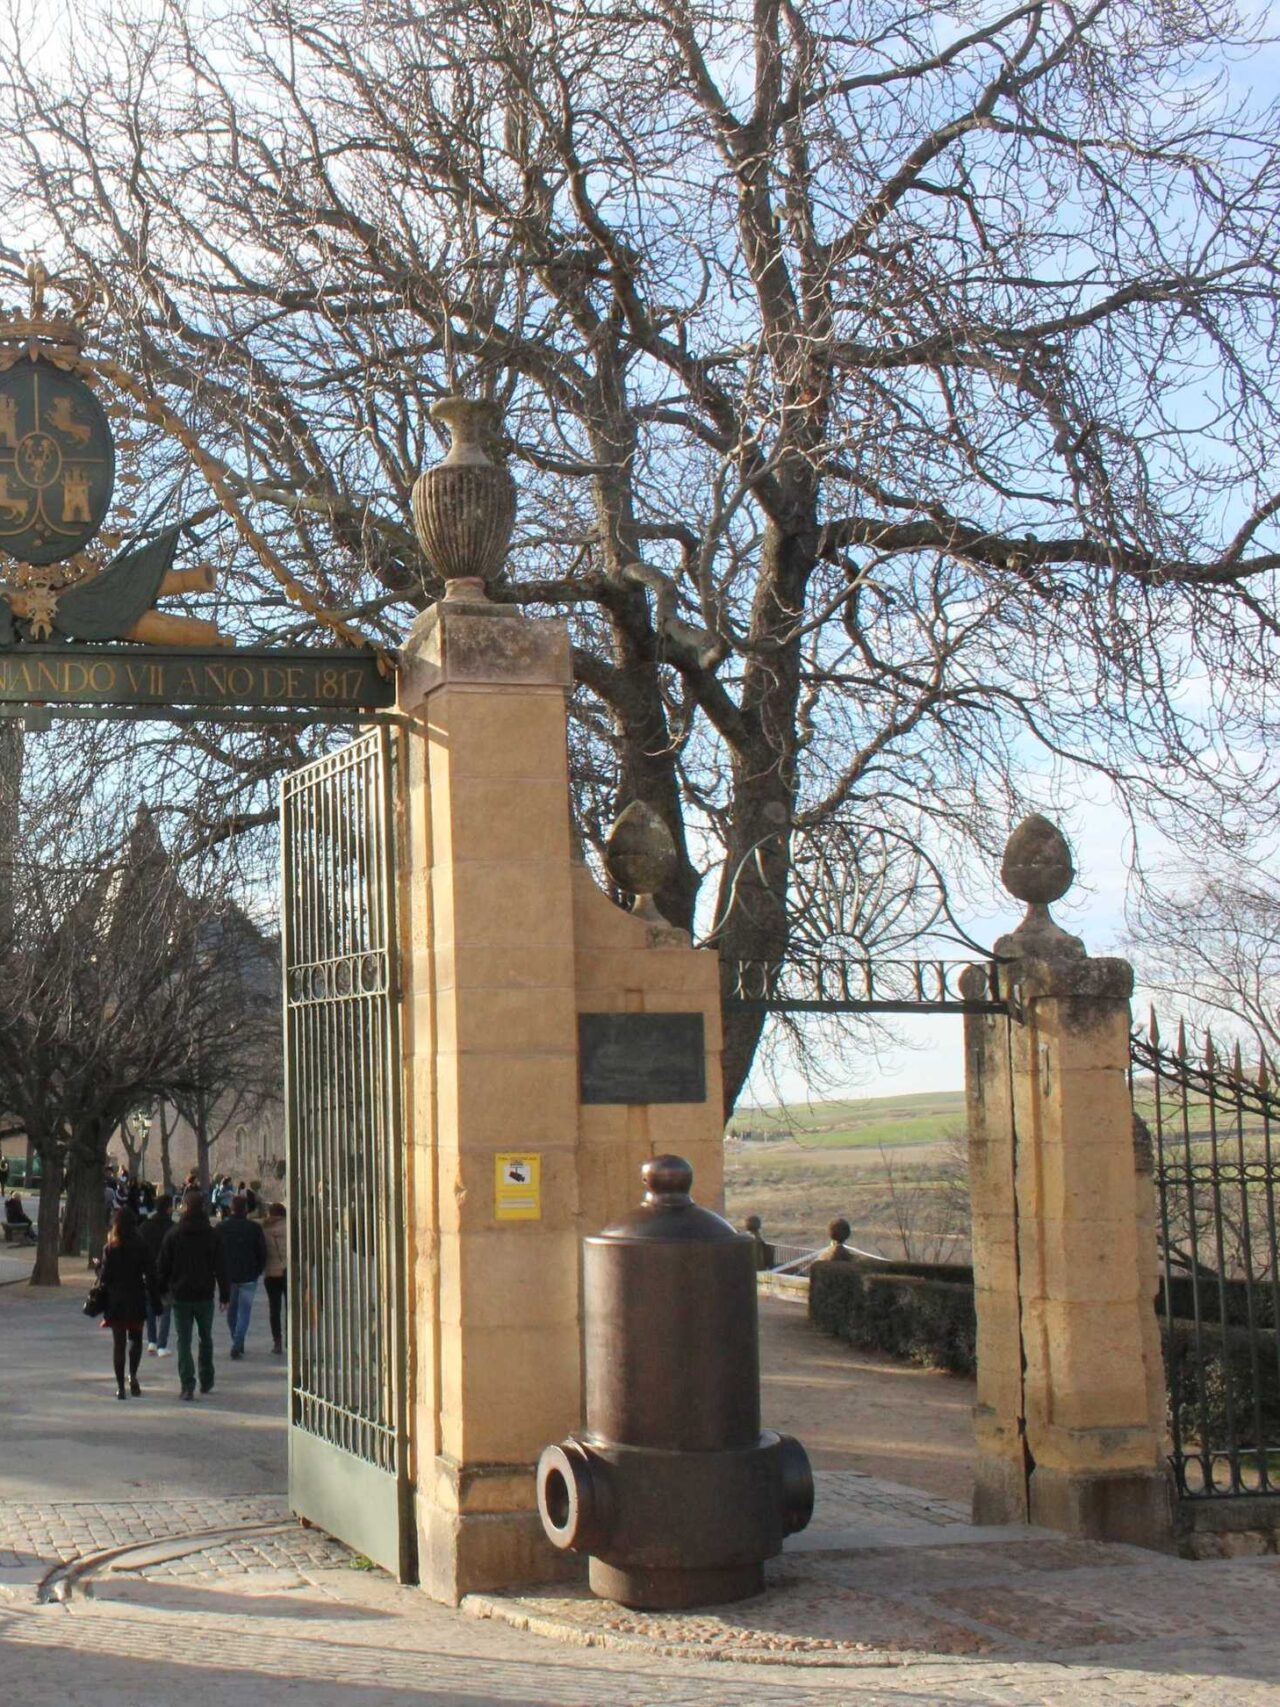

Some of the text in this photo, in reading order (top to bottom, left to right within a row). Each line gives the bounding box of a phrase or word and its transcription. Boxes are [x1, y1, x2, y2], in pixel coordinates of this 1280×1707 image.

[125, 665, 163, 696] VII
[177, 663, 254, 697] AÑO
[262, 667, 307, 699] DE
[315, 669, 365, 699] 1817
